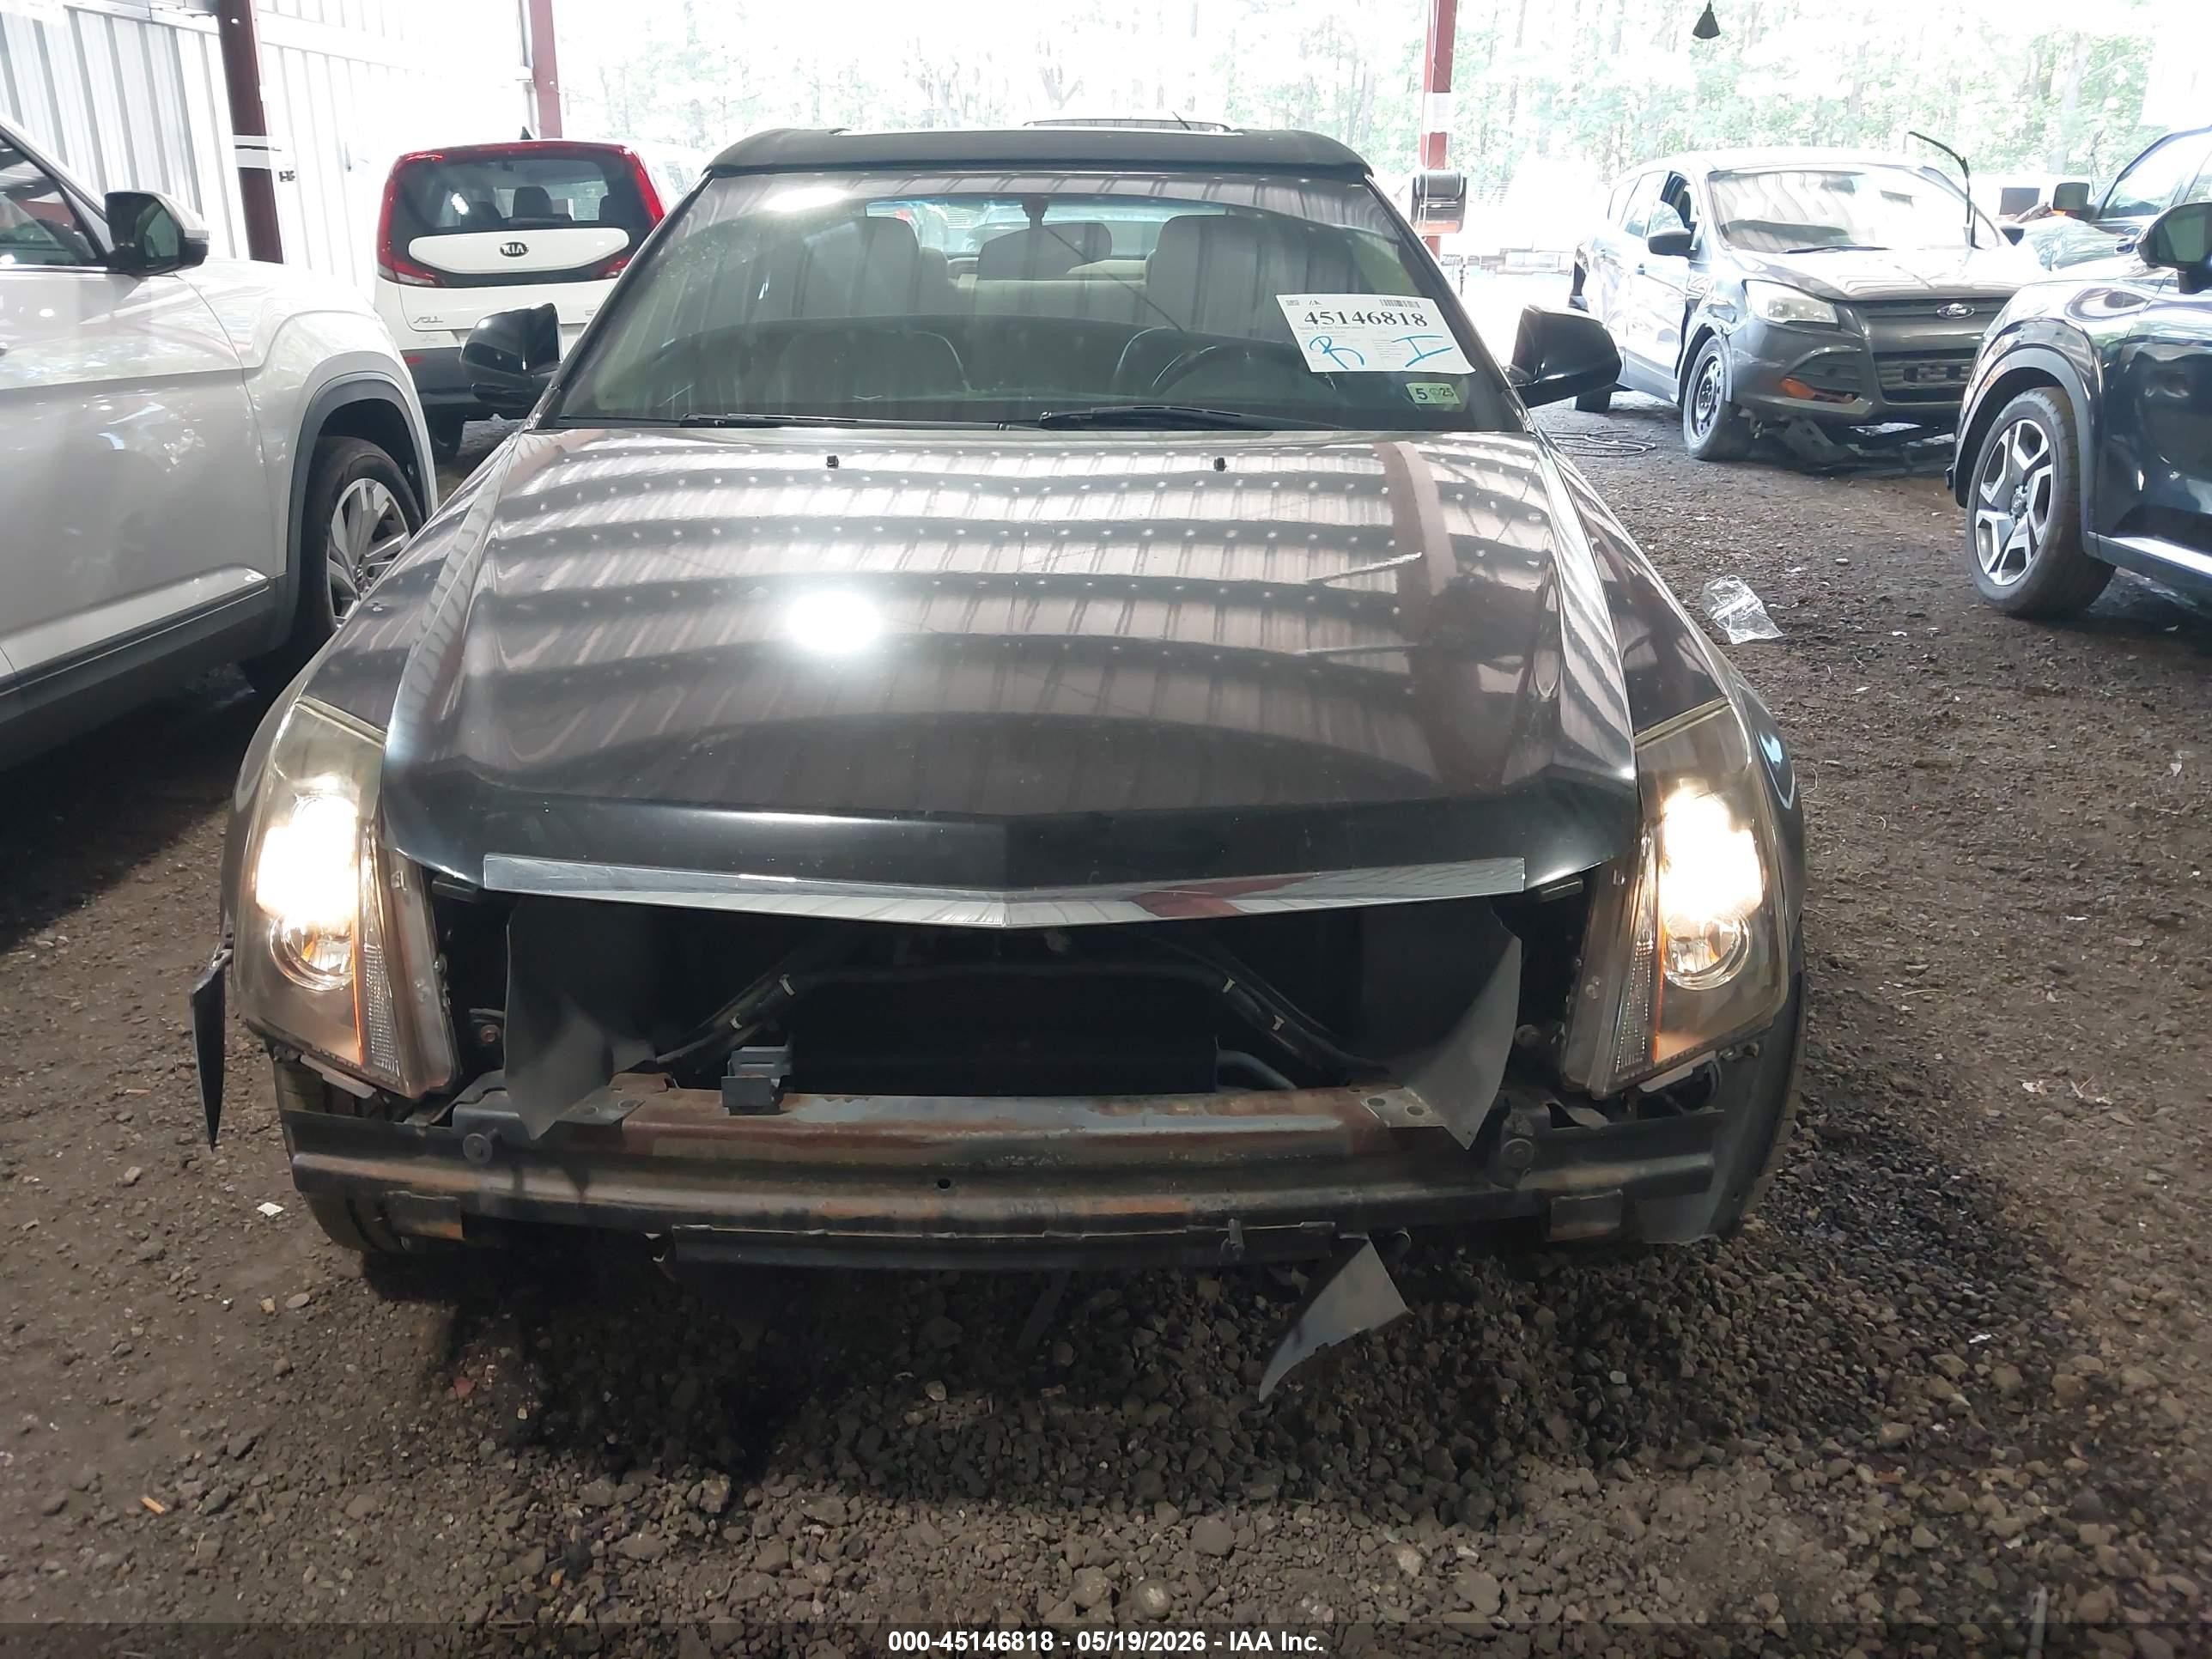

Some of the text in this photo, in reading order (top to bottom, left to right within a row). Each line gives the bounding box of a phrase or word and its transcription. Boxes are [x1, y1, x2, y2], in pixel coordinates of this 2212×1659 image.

[501, 243, 525, 254] KIA
[1304, 310, 1429, 328] 45146818
[1414, 387, 1428, 400] 5
[1439, 387, 1455, 398] 25
